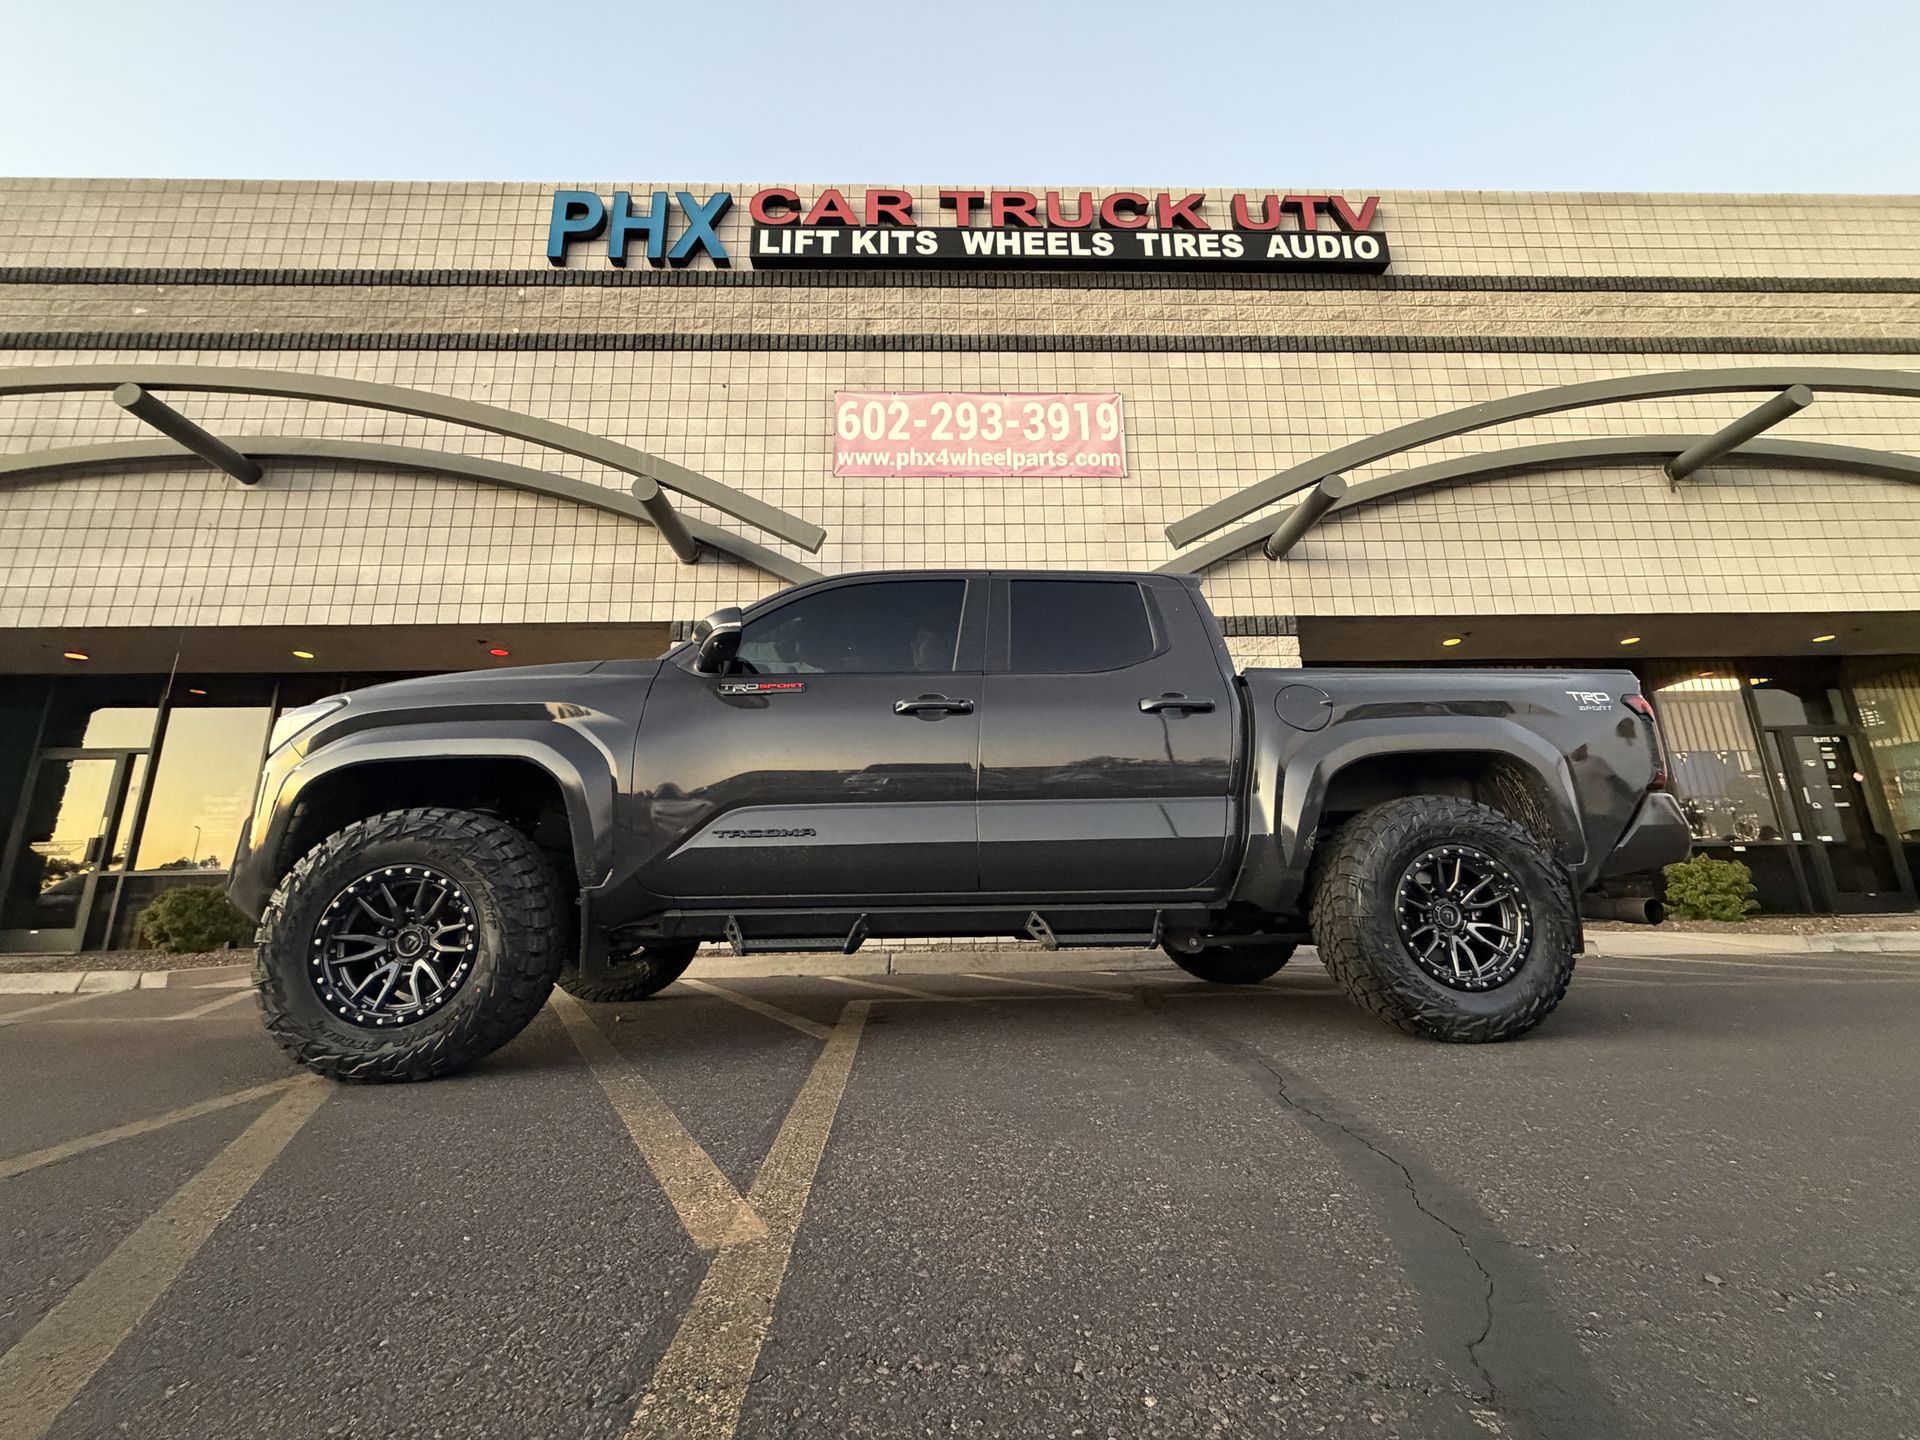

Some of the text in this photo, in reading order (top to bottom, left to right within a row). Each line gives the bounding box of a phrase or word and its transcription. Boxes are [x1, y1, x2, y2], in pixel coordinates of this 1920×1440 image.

[547, 188, 1381, 267] PHX CAR TRUCK UTV
[758, 230, 1381, 261] LIFT KITS WHEELS TIRES AUDIO
[836, 400, 1119, 442] 602-293-3919
[837, 447, 1121, 471] www.phx4wheelparts.com
[720, 683, 758, 693] TRD
[1565, 690, 1611, 705] TRD
[711, 828, 817, 839] TACOMA
